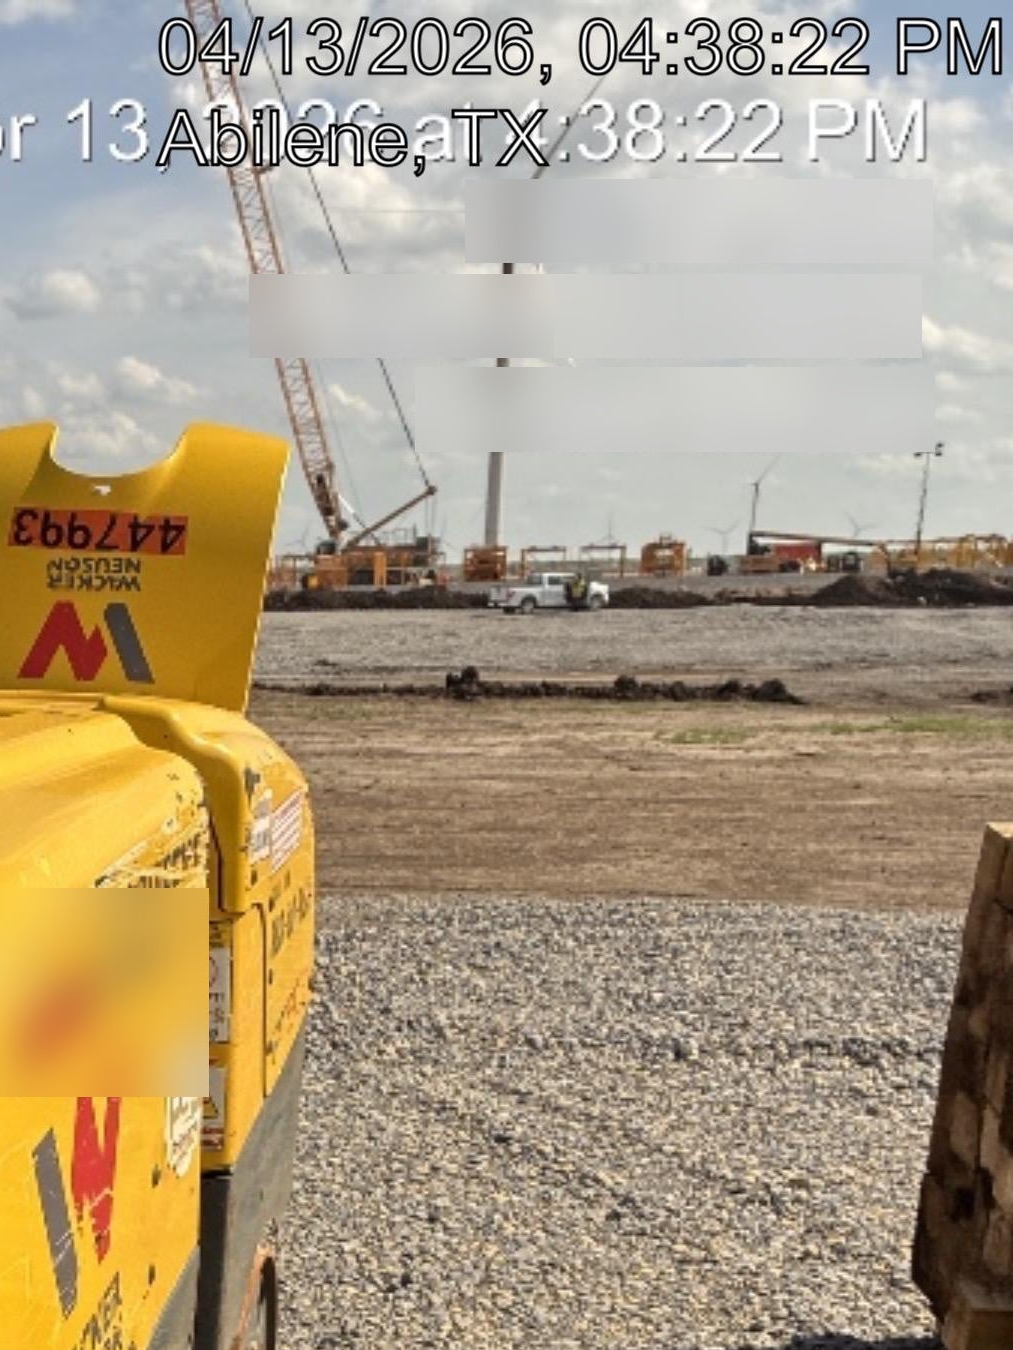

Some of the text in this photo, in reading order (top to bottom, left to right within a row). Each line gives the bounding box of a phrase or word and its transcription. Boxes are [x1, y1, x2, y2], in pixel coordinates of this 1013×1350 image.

[13, 508, 187, 553] 447993
[47, 557, 141, 575] NEUSON
[47, 575, 142, 592] WACKER
